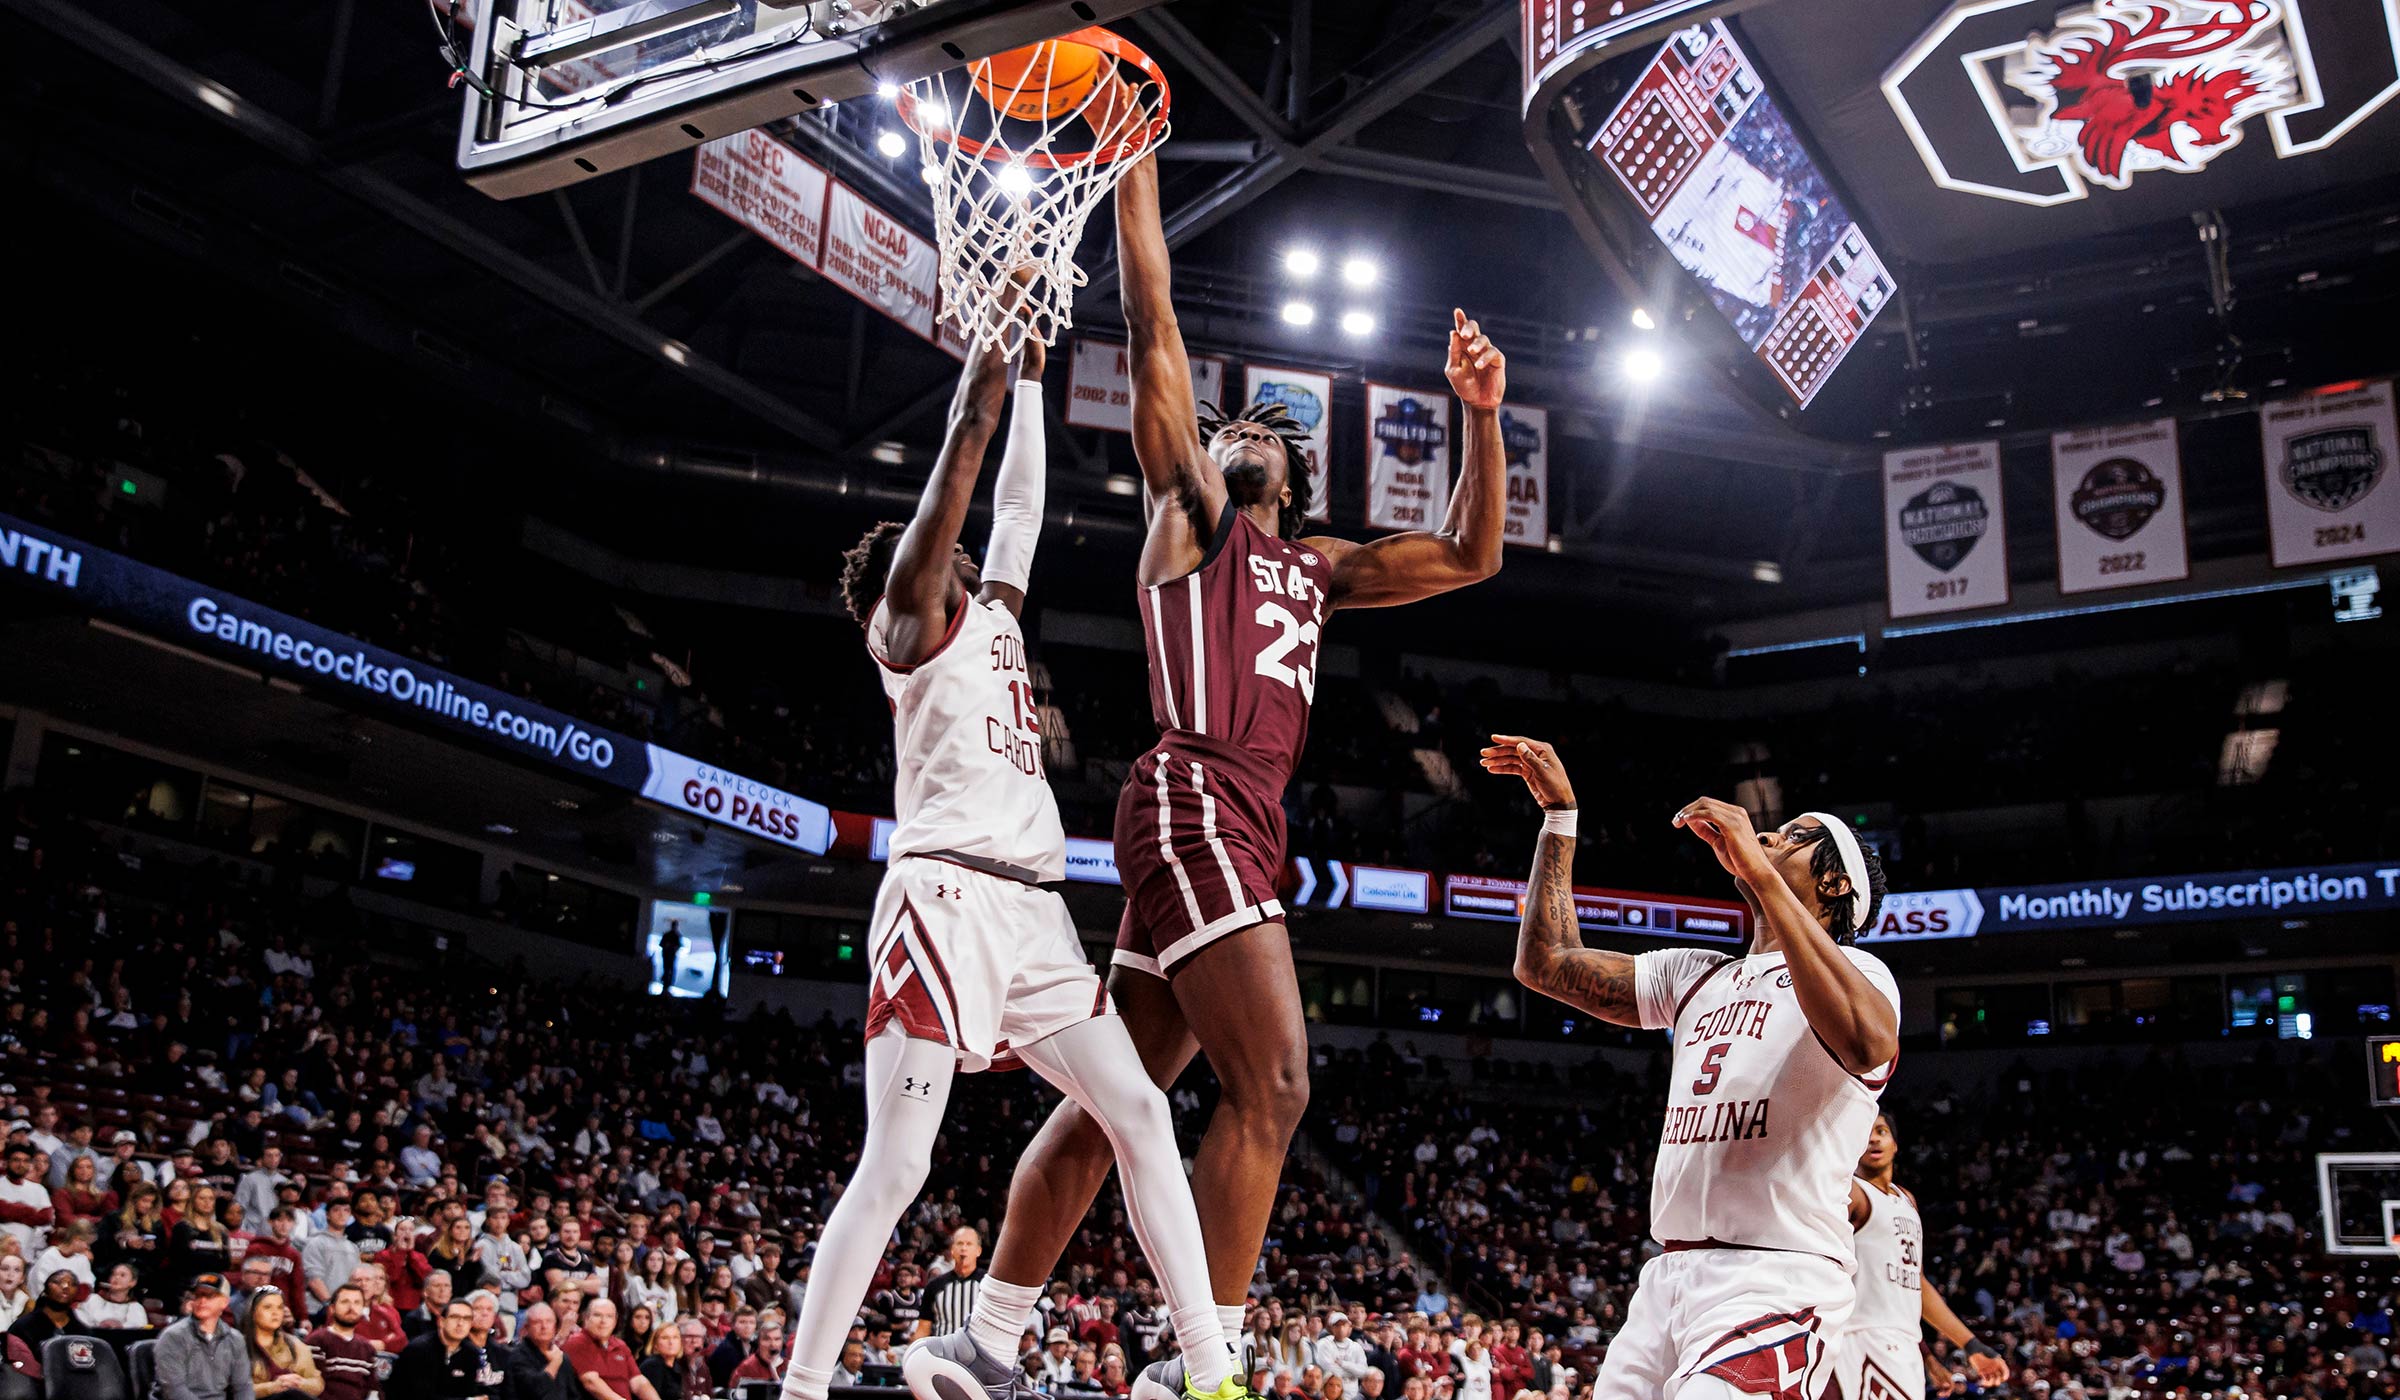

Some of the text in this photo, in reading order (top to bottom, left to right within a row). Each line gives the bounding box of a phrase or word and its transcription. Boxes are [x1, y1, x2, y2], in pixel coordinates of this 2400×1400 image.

[751, 133, 783, 177] SEC
[864, 210, 908, 260] NCAA
[1111, 391, 1129, 407] 20
[1509, 474, 1540, 504] AA
[2314, 522, 2366, 547] 2024
[2098, 551, 2146, 575] 2022
[1248, 554, 1325, 626] STATE
[1926, 577, 1968, 600] 2017
[991, 634, 1025, 673] SOU
[1255, 600, 1320, 706] 23
[187, 597, 615, 769] GamecocksOnline.com/GO
[1008, 679, 1041, 736] 15
[697, 765, 793, 810] GAMECOCK
[683, 778, 800, 842] GO PASS
[1065, 855, 1102, 867] UGHT
[1362, 886, 1418, 900] Colonial Life
[1452, 894, 1516, 911] TENNESSEE
[1486, 878, 1516, 889] TOWN
[1999, 886, 2133, 921] Monthly
[2141, 872, 2368, 913] Subscription
[1684, 917, 1730, 932] AUBURN
[1685, 1000, 1773, 1047] SOUTH
[1692, 1042, 1733, 1096] 5
[1663, 1098, 1770, 1145] AROLINA
[1901, 1238, 1918, 1267] 30
